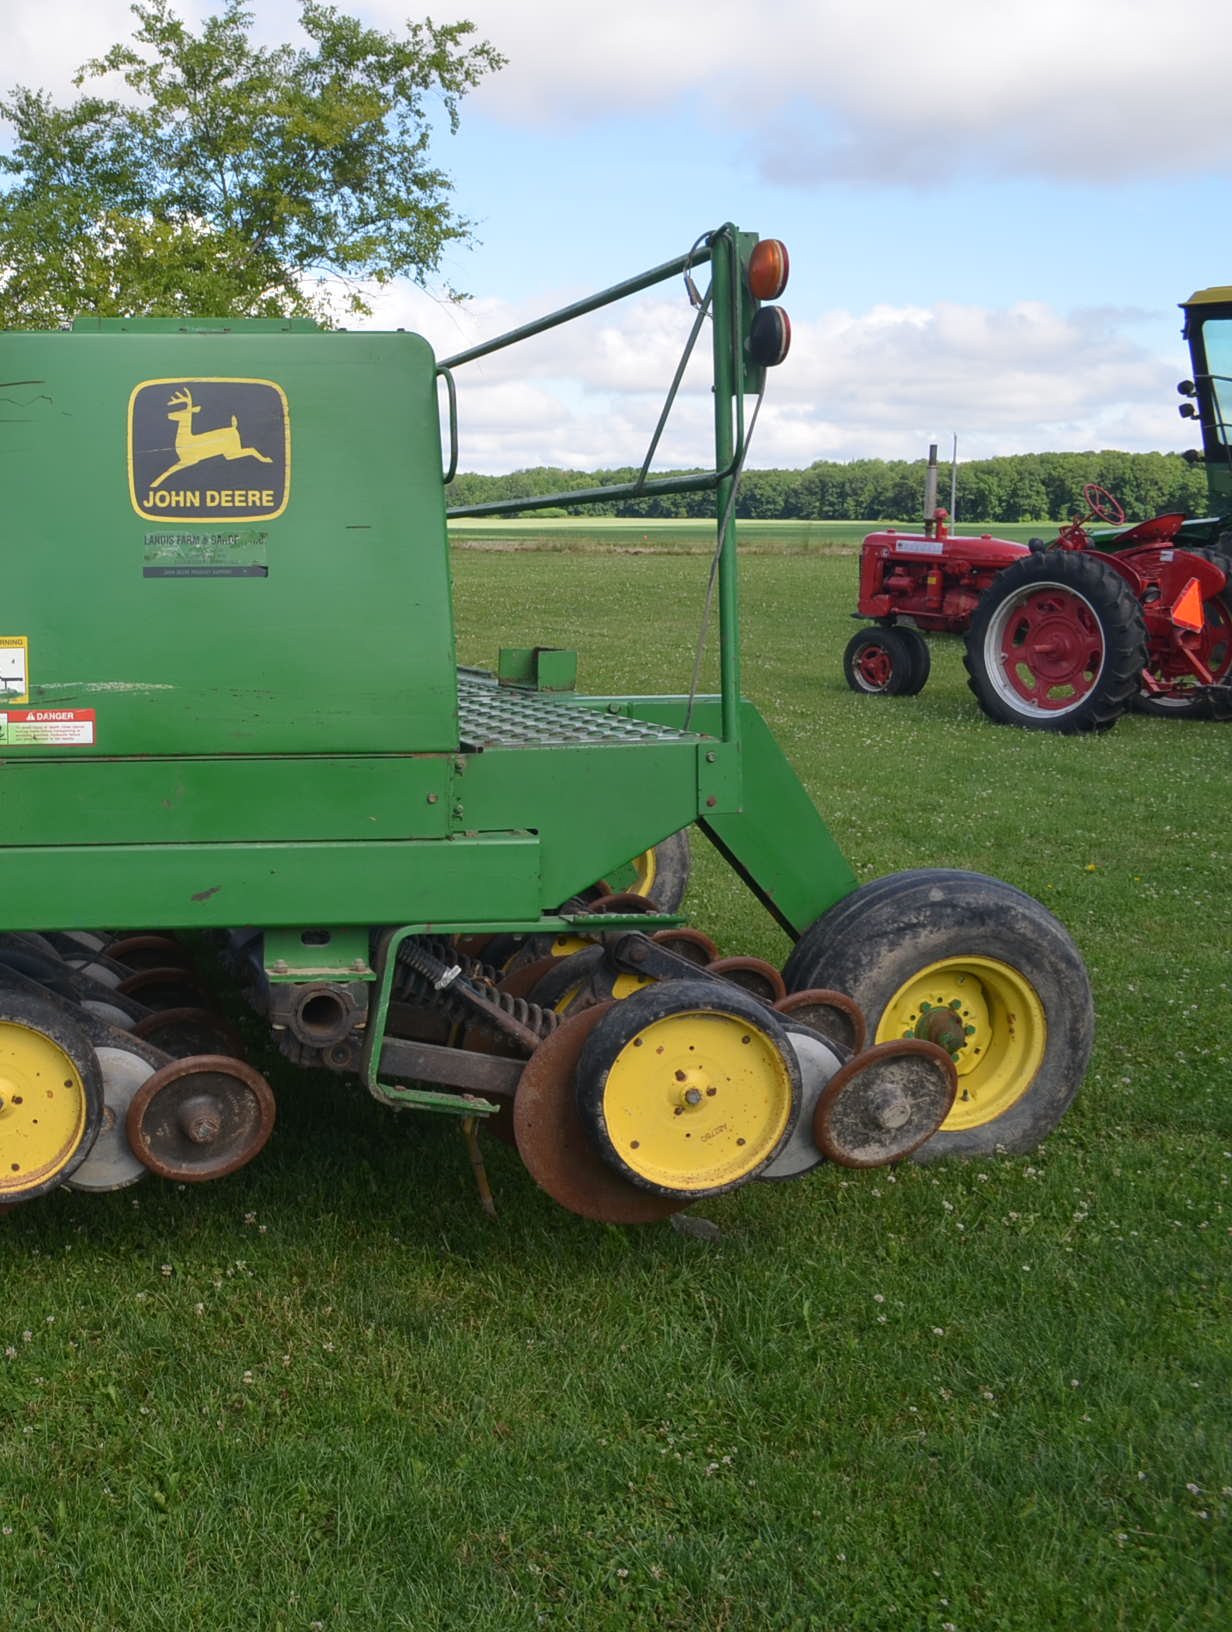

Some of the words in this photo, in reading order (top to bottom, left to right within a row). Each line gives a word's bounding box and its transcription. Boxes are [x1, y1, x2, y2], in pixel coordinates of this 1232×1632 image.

[143, 490, 200, 508] JOHN
[206, 490, 275, 507] DEERE
[144, 535, 175, 546] LANDIS
[176, 535, 200, 546] FARM
[36, 712, 75, 721] DANGER
